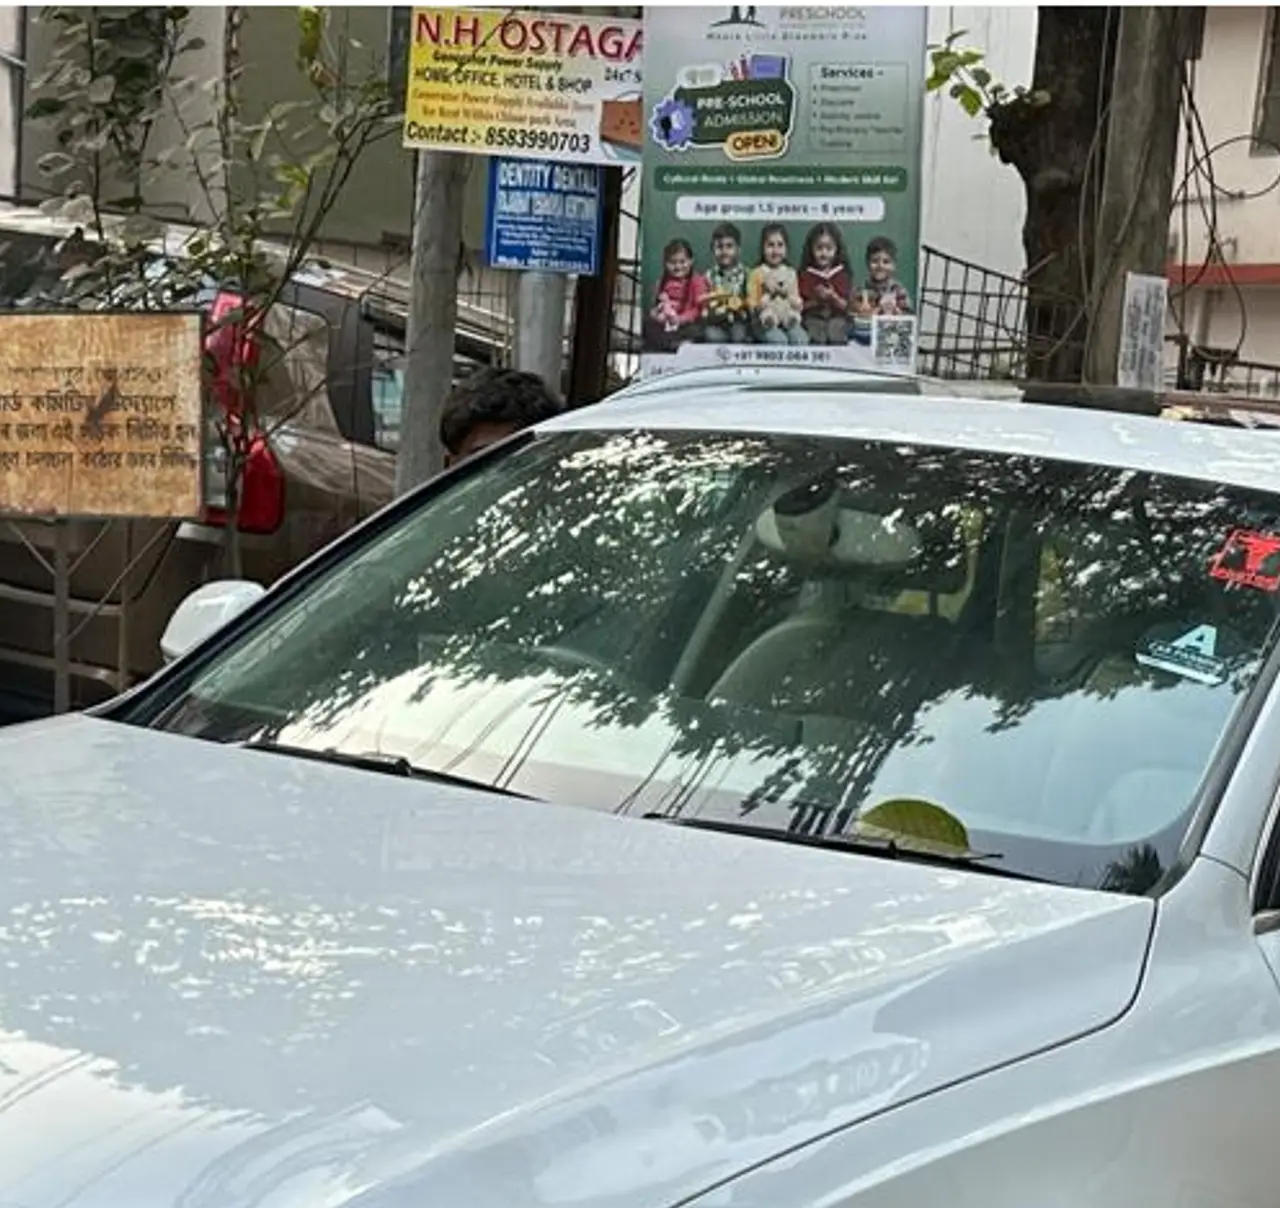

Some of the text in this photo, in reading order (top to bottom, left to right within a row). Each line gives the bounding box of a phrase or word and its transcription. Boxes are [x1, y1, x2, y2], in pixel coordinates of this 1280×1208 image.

[490, 54, 524, 67] Power
[526, 56, 562, 71] Supply
[821, 67, 873, 78] Services
[504, 74, 541, 90] HOTEL
[545, 77, 554, 90] &
[558, 76, 592, 93] SHOP
[697, 93, 784, 109] PRE-SCHOOL
[704, 111, 783, 127] ADMISSION
[408, 121, 468, 143] Contact
[485, 126, 590, 153] 8583990703
[695, 202, 717, 215] Age
[721, 203, 755, 215] group
[776, 204, 808, 215] years
[832, 204, 864, 215] years
